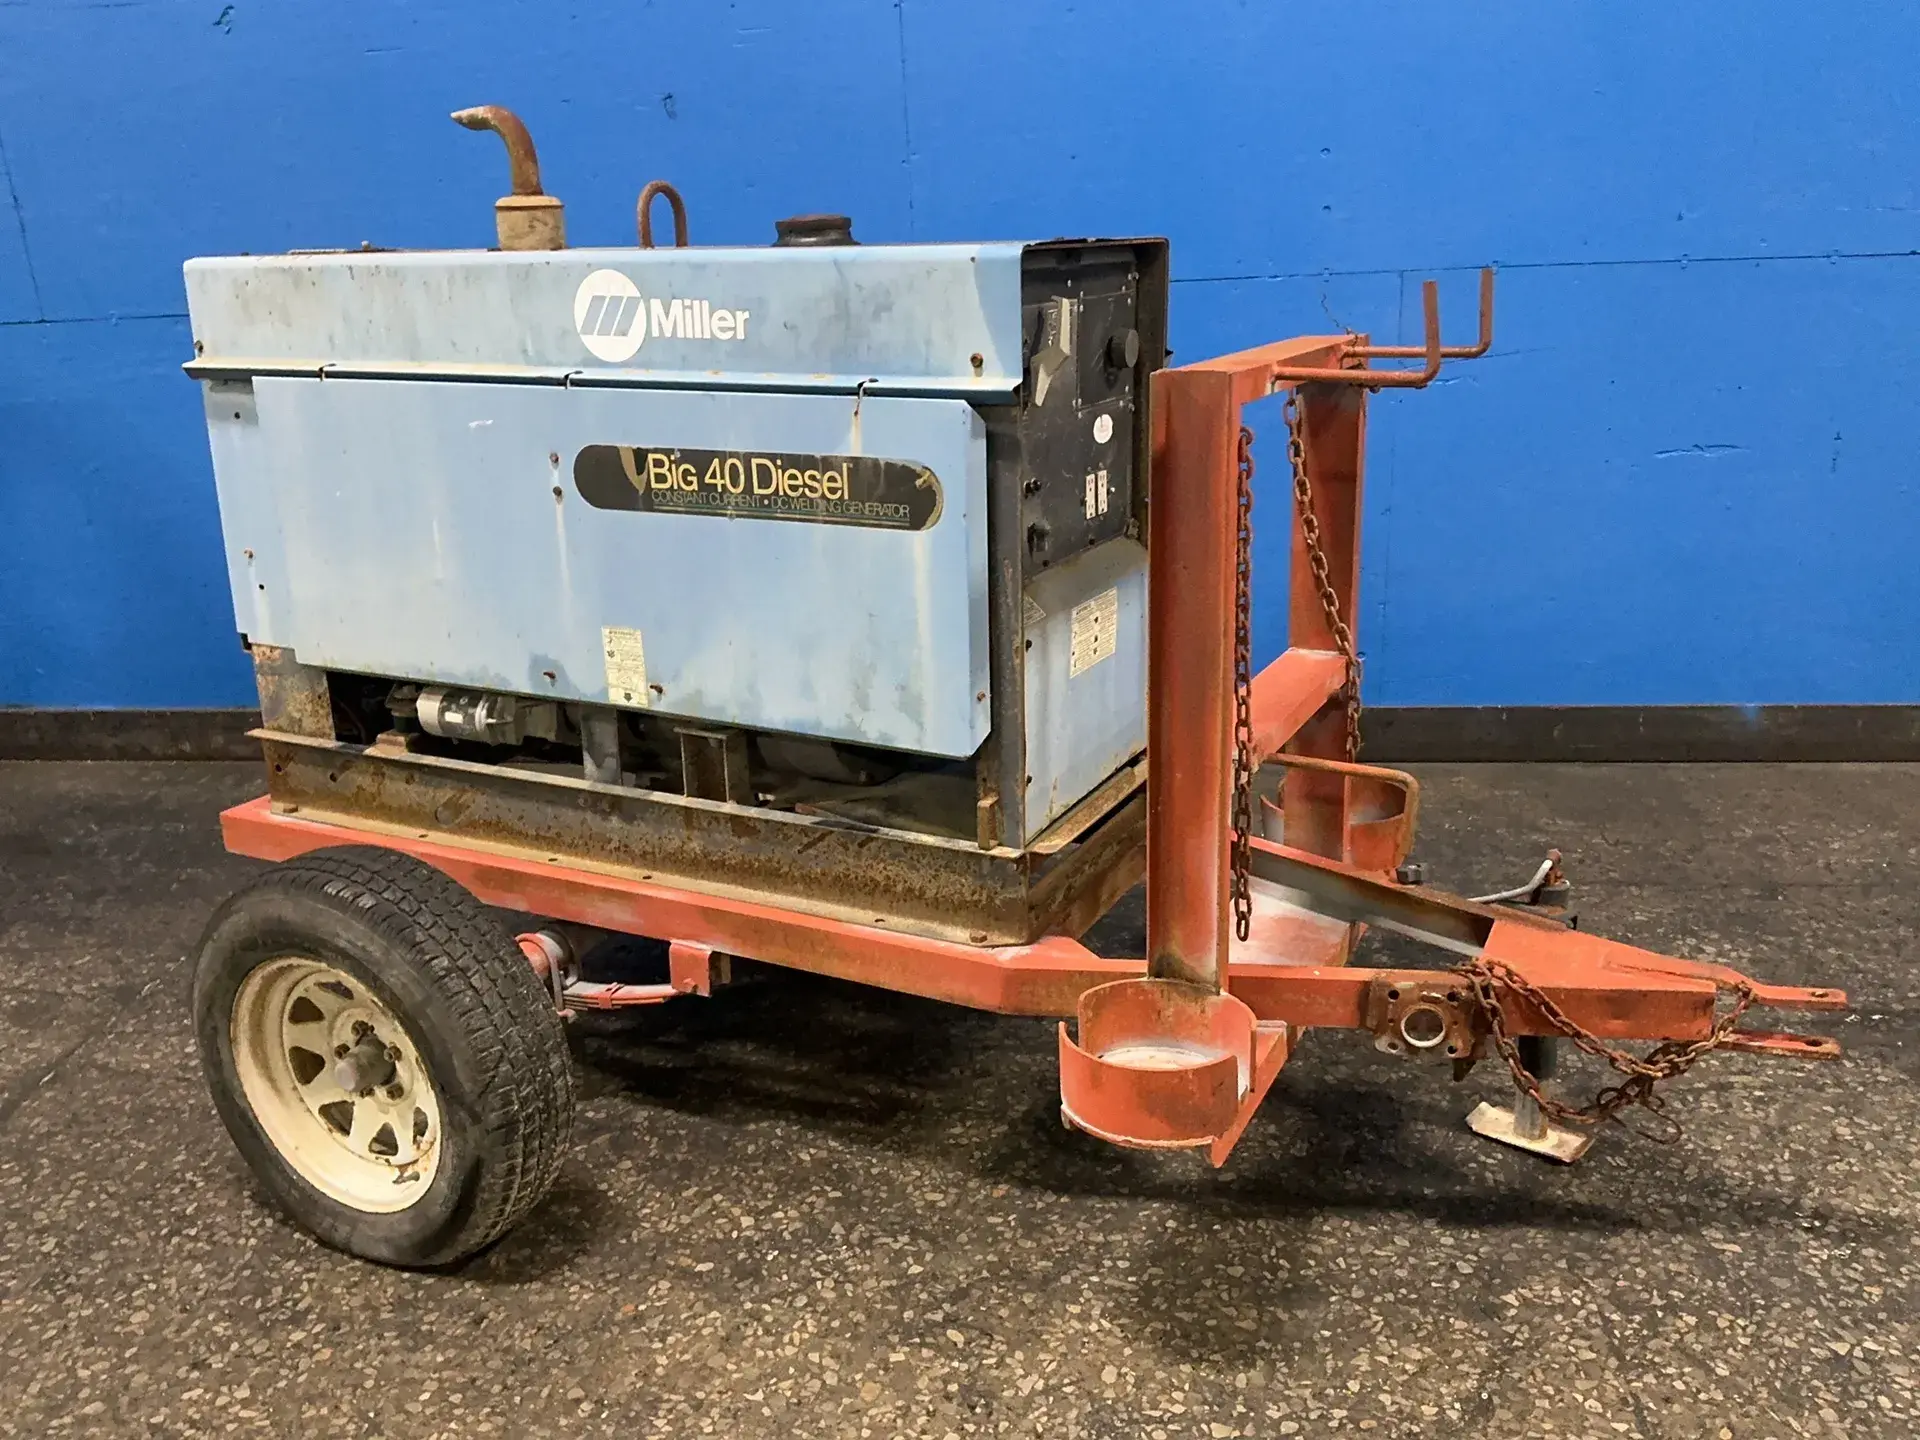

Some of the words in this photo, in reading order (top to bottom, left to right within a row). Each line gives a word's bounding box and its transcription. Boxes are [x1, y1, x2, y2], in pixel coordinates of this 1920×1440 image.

[650, 298, 750, 340] Miller
[704, 457, 745, 494] 40
[751, 457, 849, 500] Diesel
[651, 489, 708, 503] CONSTANT
[708, 491, 760, 507] CURRENT
[771, 496, 788, 509] DC
[843, 501, 910, 518] GENERATOR
